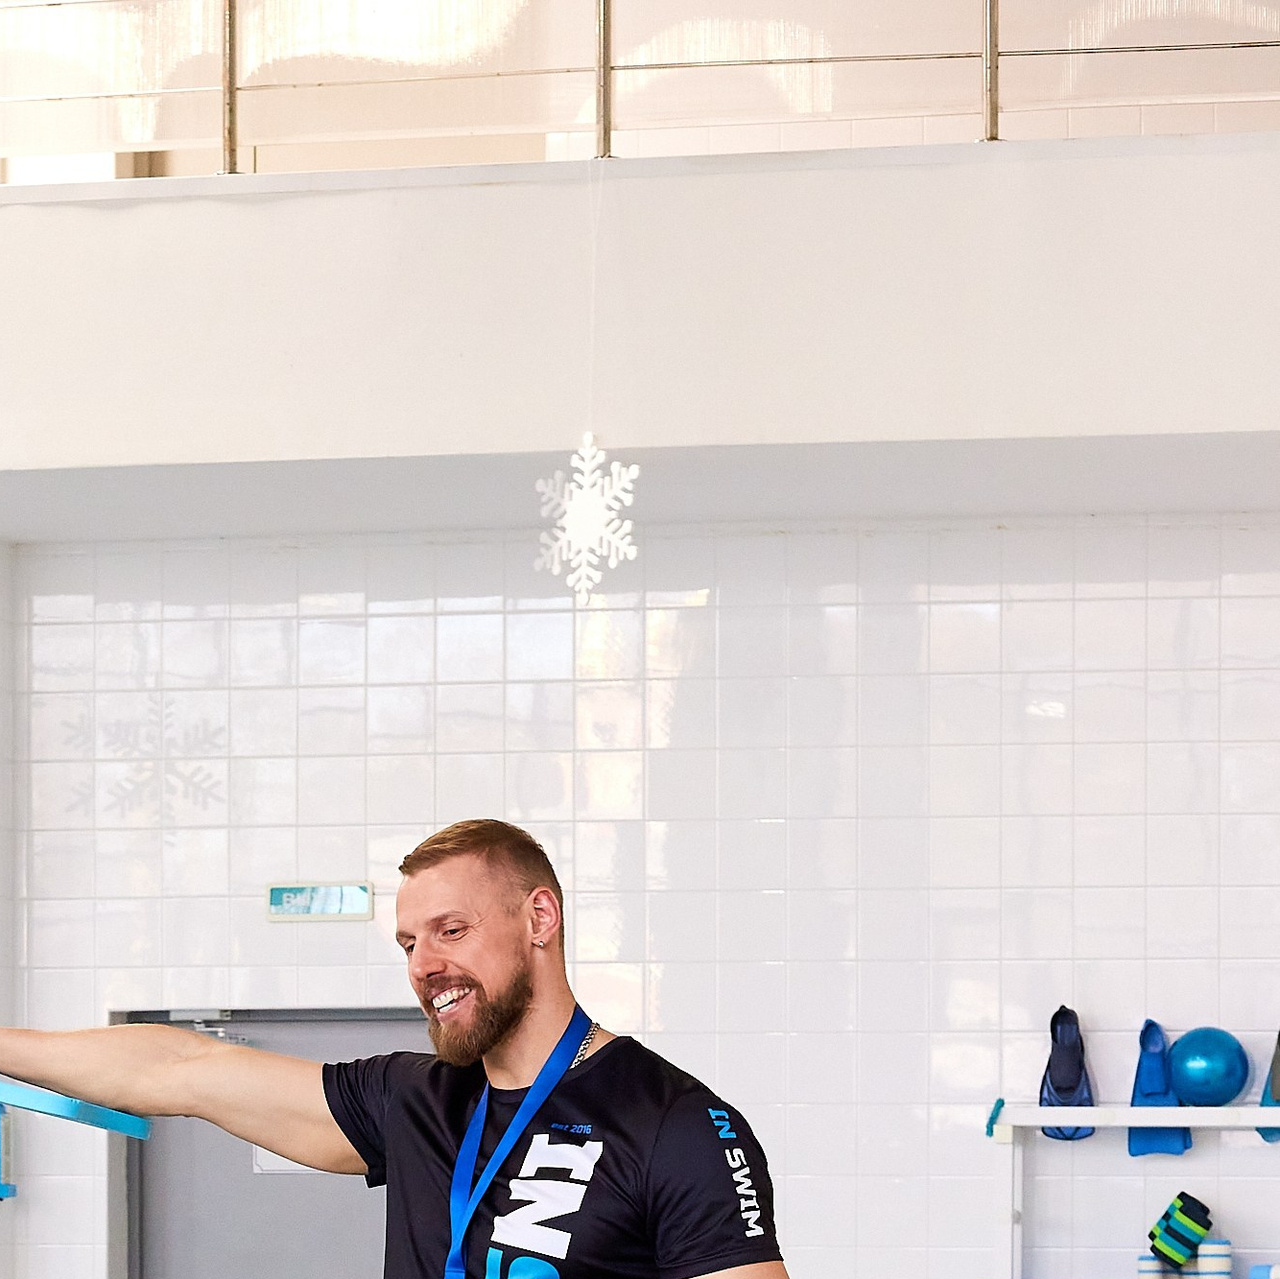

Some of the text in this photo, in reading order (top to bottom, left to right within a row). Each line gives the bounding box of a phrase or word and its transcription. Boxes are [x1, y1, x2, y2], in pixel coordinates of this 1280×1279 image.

[570, 1124, 592, 1134] 2016
[708, 1108, 764, 1237] IN SWIM
